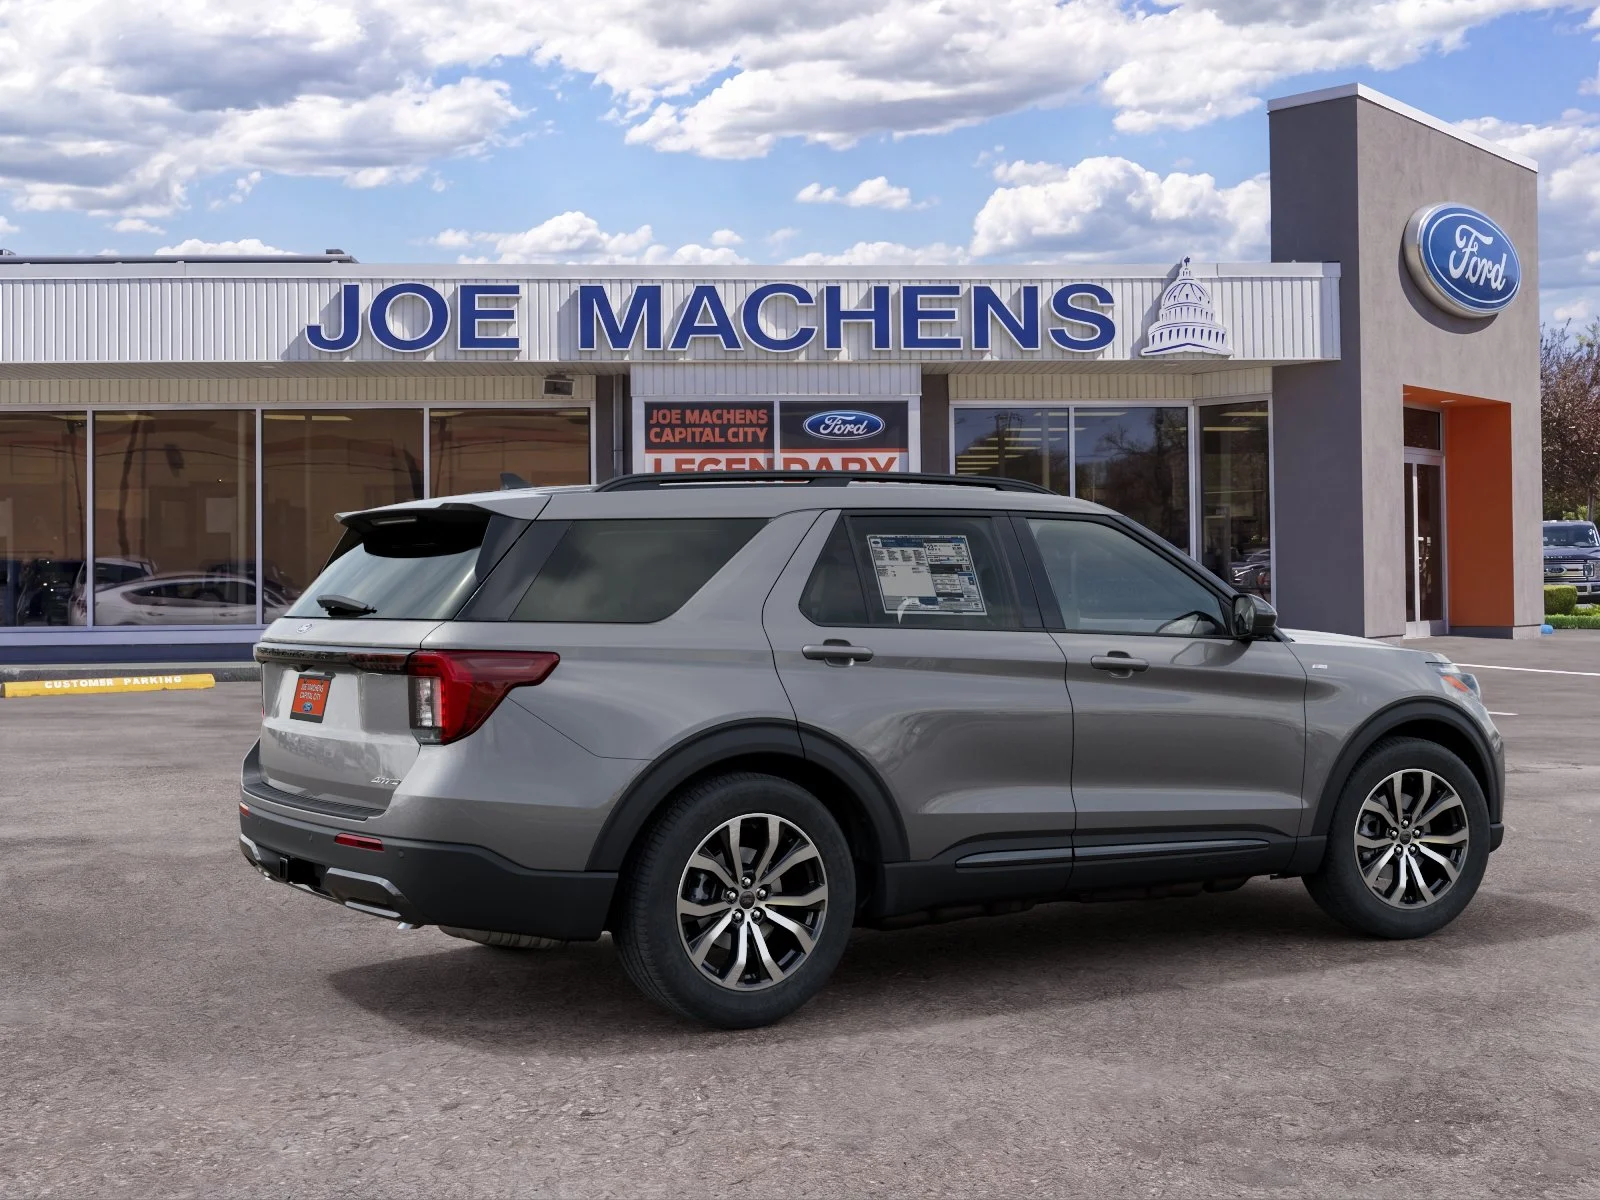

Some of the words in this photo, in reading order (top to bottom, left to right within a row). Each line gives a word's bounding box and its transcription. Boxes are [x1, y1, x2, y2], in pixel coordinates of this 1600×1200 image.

[1448, 224, 1508, 292] Ford
[305, 281, 522, 353] JOE
[577, 282, 1118, 353] MACHENS
[649, 409, 680, 424] JOE
[686, 409, 768, 425] MACHENS
[820, 415, 868, 435] Ford
[649, 428, 724, 443] CAPITAL
[727, 427, 768, 443] CITY
[45, 678, 114, 689] CUSTOMER
[123, 676, 182, 686] PARKING
